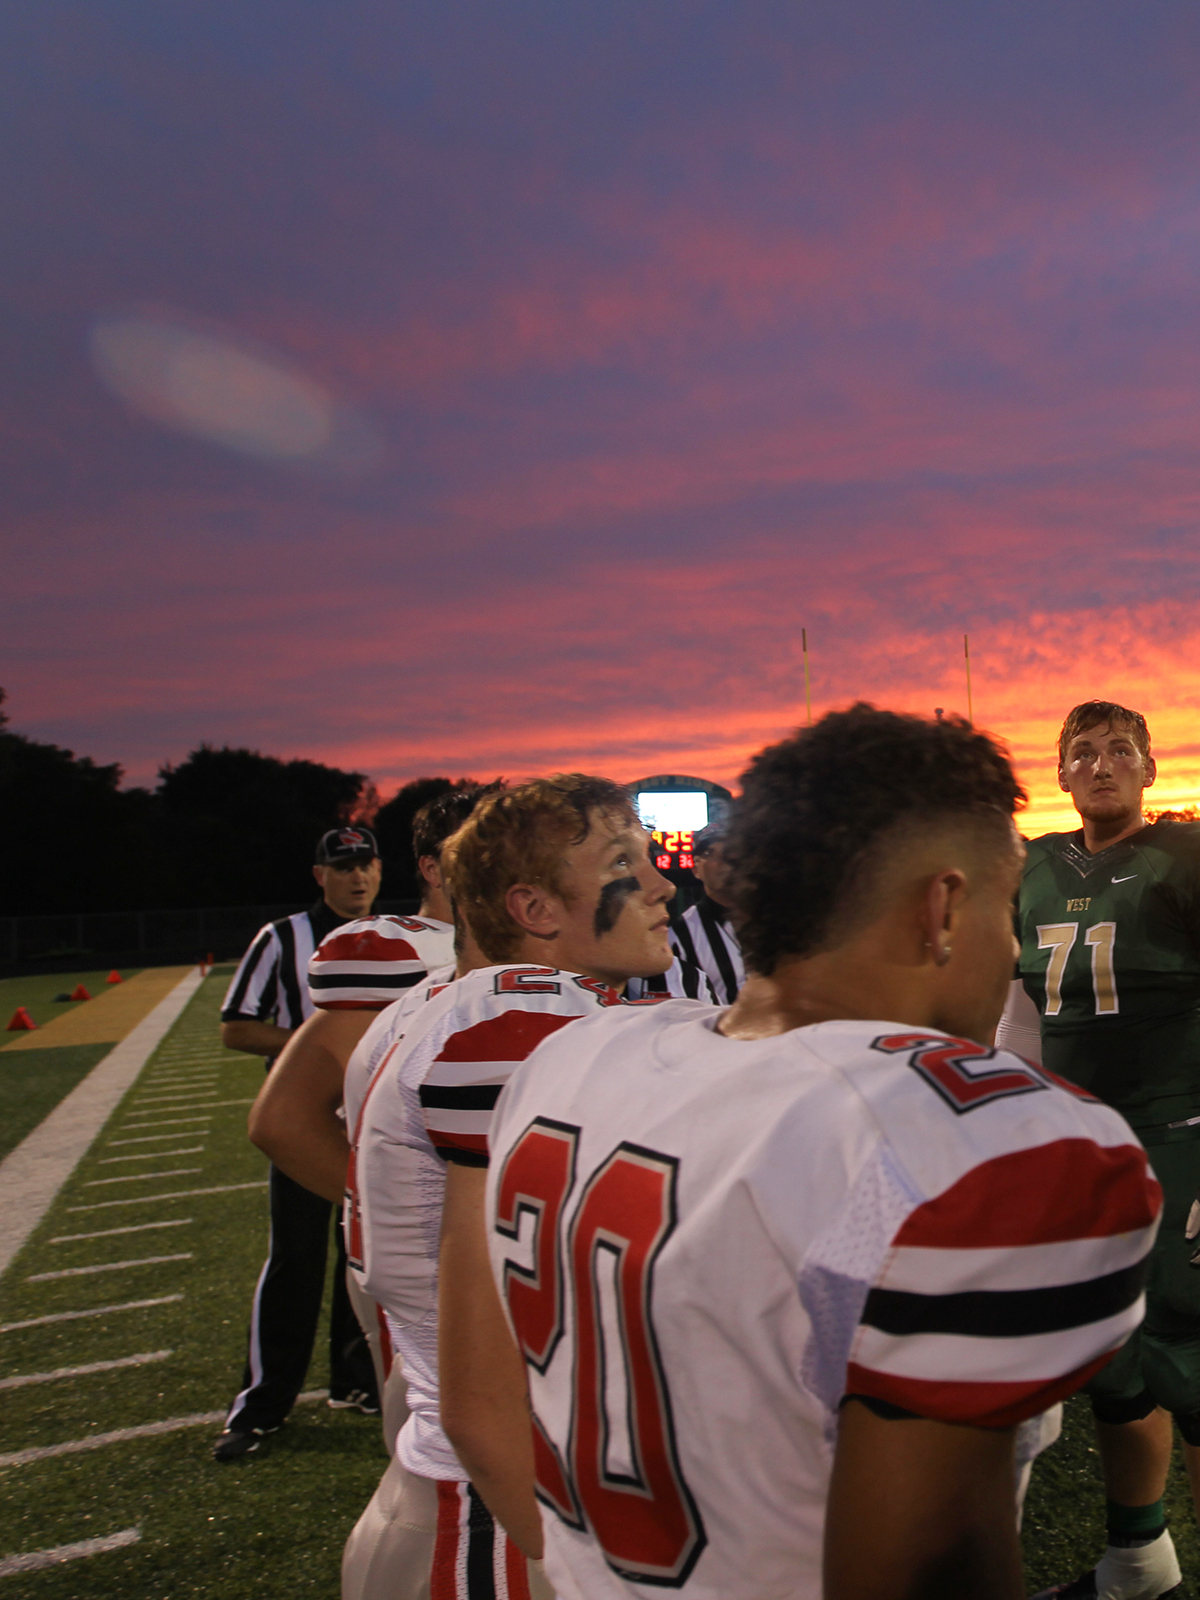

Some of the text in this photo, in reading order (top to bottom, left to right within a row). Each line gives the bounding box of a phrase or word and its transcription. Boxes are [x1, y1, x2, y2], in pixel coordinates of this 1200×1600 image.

[1066, 897, 1092, 912] WEST
[1036, 922, 1119, 1015] 71
[495, 1115, 708, 1589] 20
